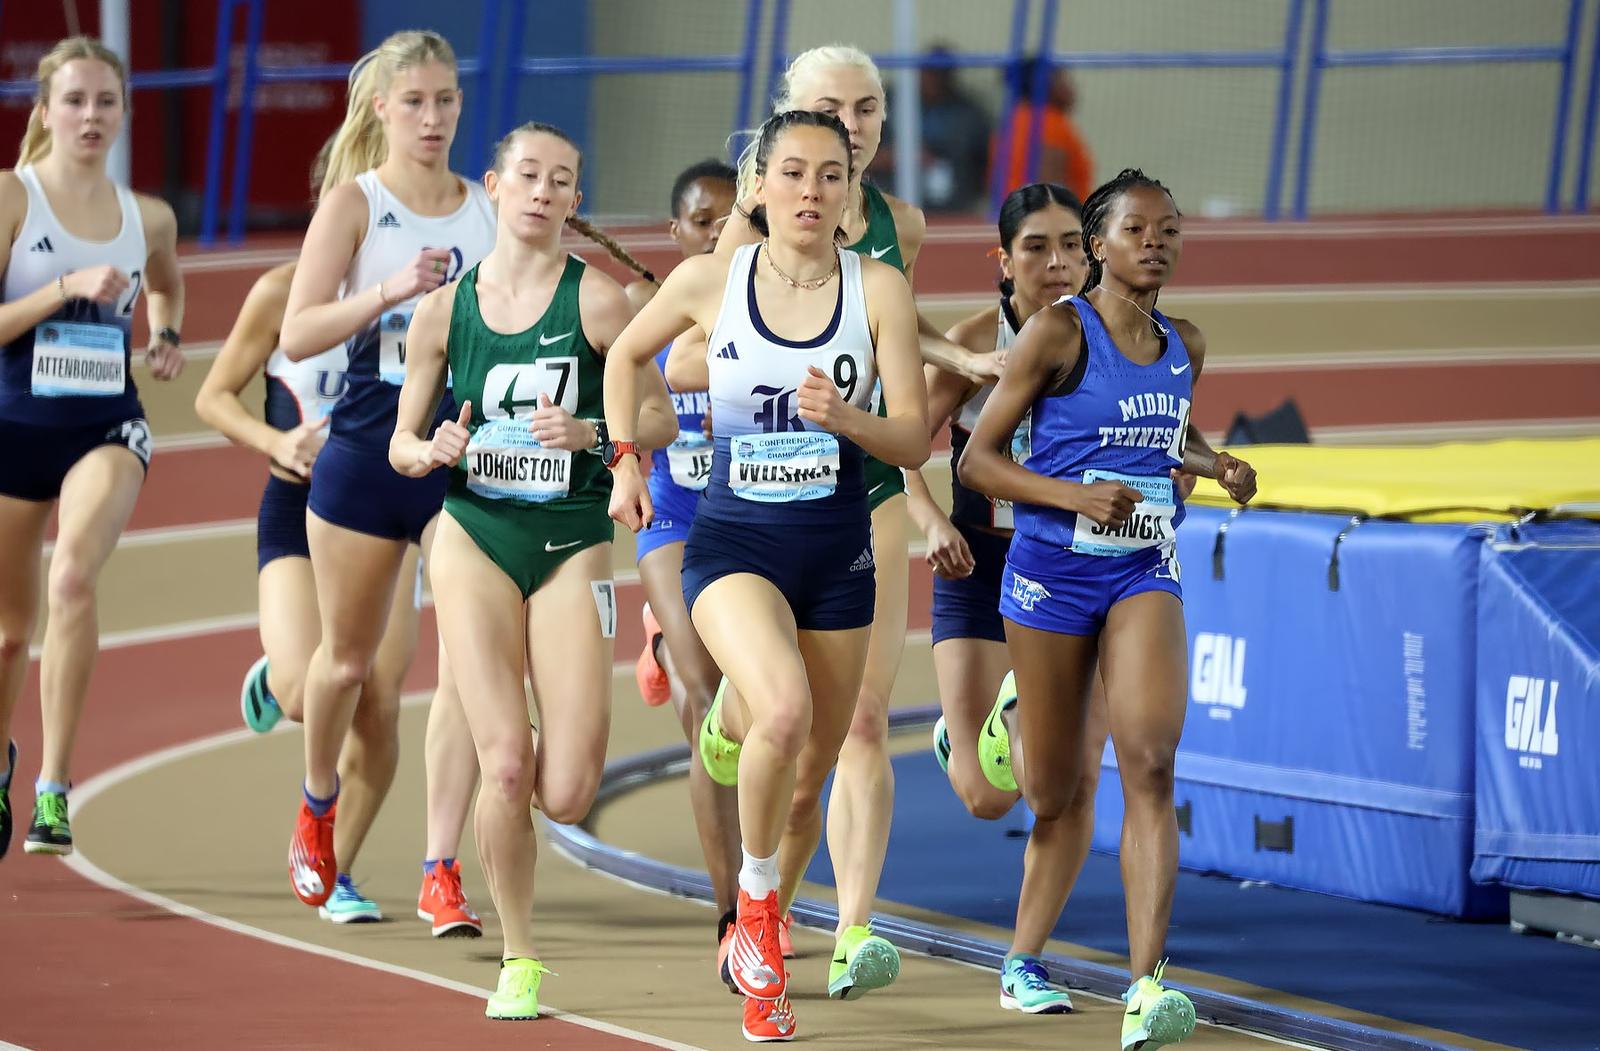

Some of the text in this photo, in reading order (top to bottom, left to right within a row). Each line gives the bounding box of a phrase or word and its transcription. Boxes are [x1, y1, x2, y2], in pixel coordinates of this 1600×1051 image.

[36, 355, 122, 383] ATTENBOROUGH
[317, 370, 349, 399] U
[545, 362, 571, 407] 7
[833, 353, 858, 403] 9
[472, 452, 566, 482] JOHNSTON
[598, 584, 613, 635] 7
[1192, 632, 1247, 710] GILL
[1505, 674, 1560, 756] GILL
